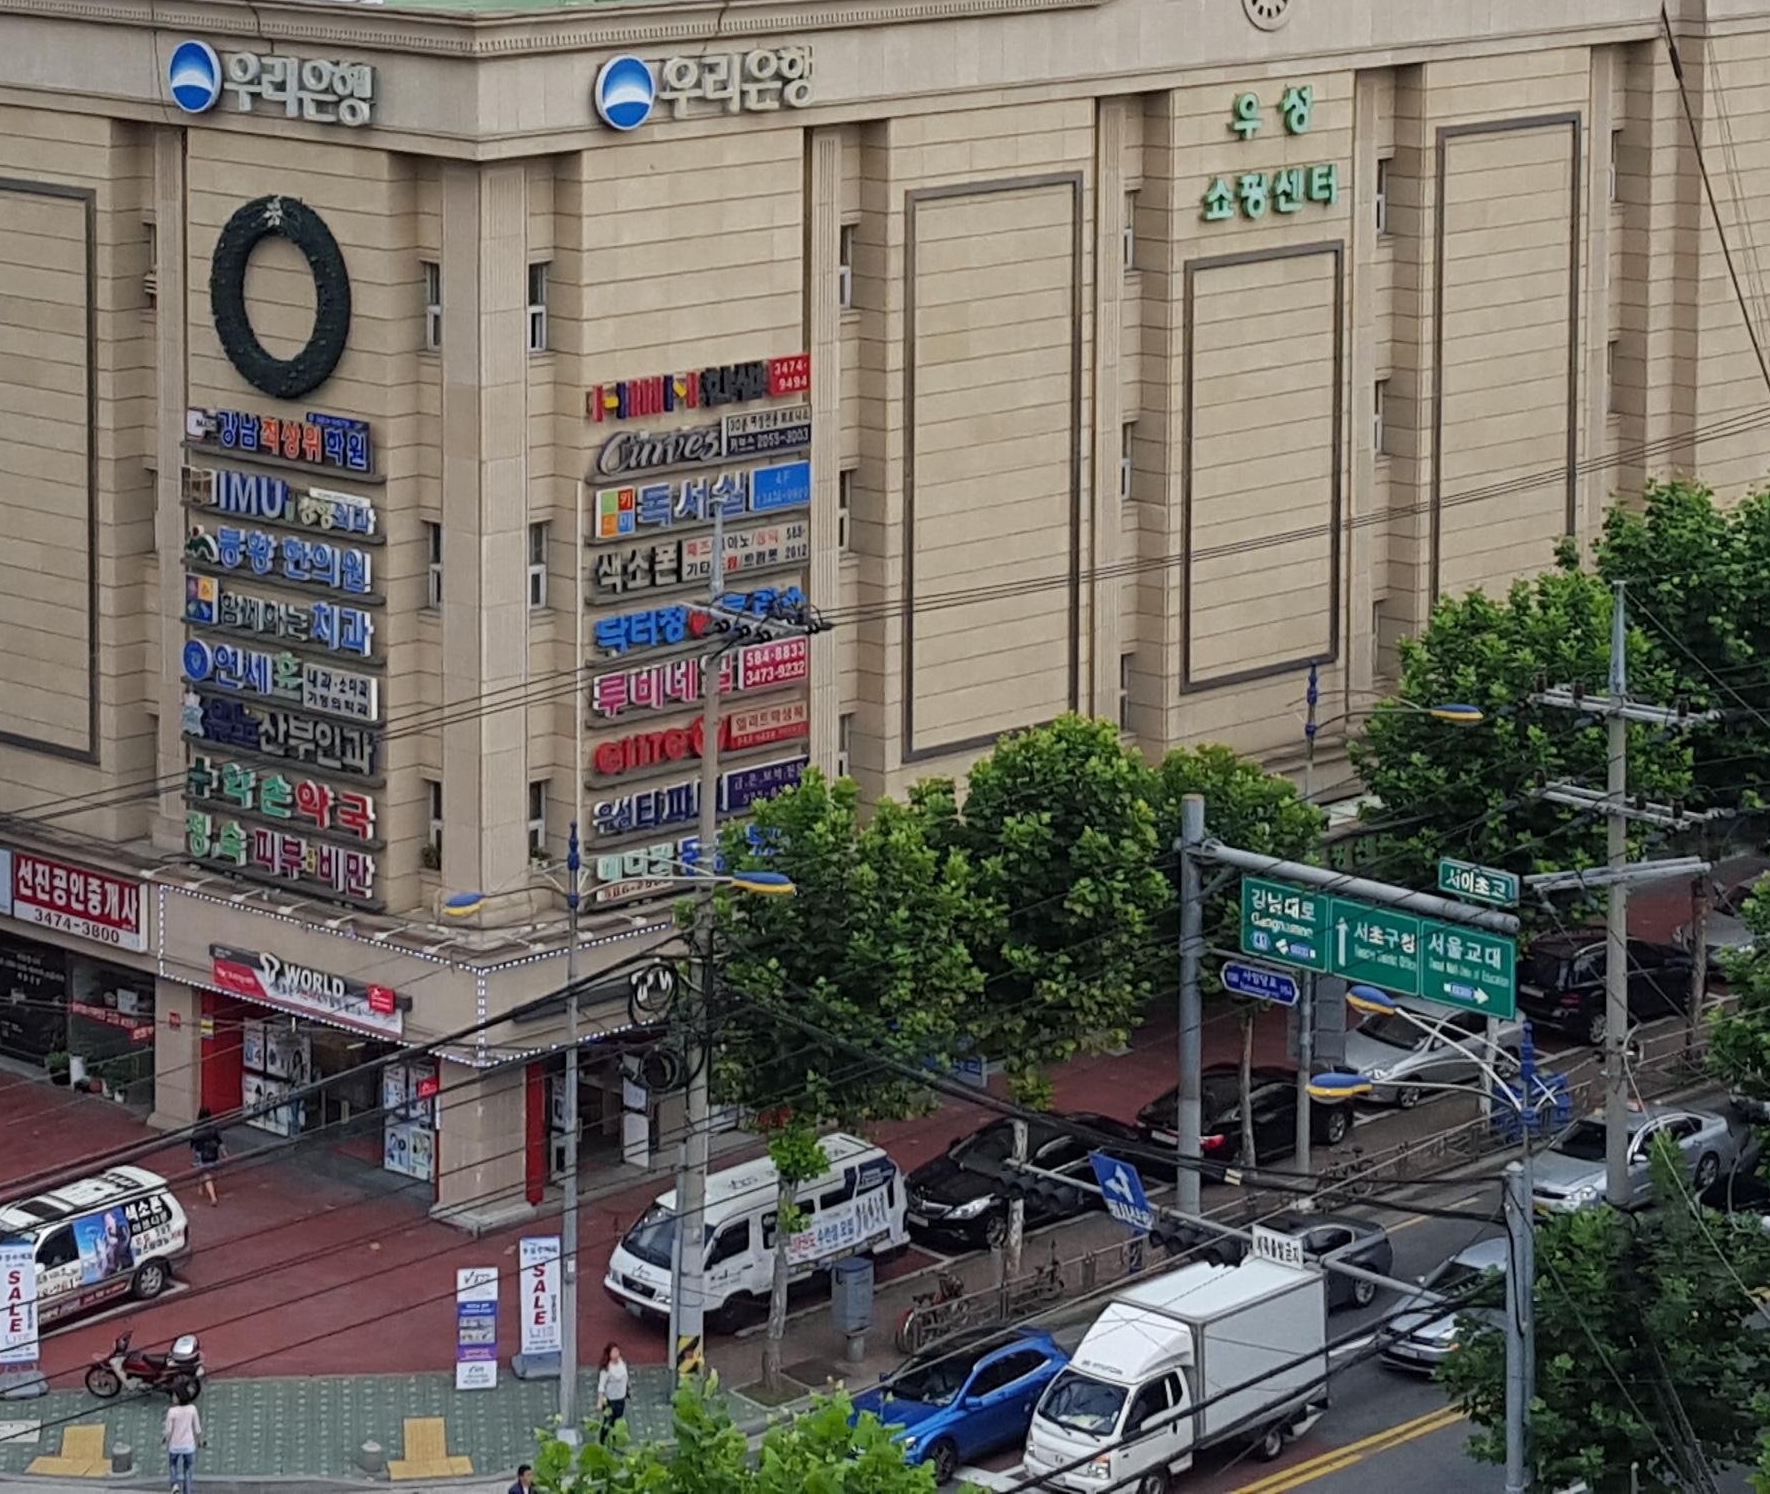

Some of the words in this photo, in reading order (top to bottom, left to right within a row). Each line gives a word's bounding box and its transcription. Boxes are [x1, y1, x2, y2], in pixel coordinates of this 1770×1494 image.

[222, 49, 376, 128] 우리은행
[657, 44, 818, 119] 우리은행
[1202, 163, 1340, 222] 쇼핑센터
[218, 468, 289, 520] IMU
[637, 471, 748, 528] 독서실
[282, 535, 372, 594] 한의원
[597, 542, 678, 594] 색소폰
[310, 601, 375, 658] 치과
[744, 640, 807, 666] 584-8833
[744, 660, 807, 686] 3473-9232
[259, 713, 378, 777] 산부인과
[17, 857, 140, 926] 선진공인중개사
[1250, 888, 1316, 922] 강남대로
[1445, 869, 1508, 899] 서이초교
[33, 908, 122, 945] 3474-3800
[1354, 922, 1417, 950] 서초구청
[1428, 932, 1501, 971] 서울교대
[284, 963, 346, 998] WORLD
[7, 1269, 24, 1333] SALE
[532, 1263, 547, 1326] SALE
